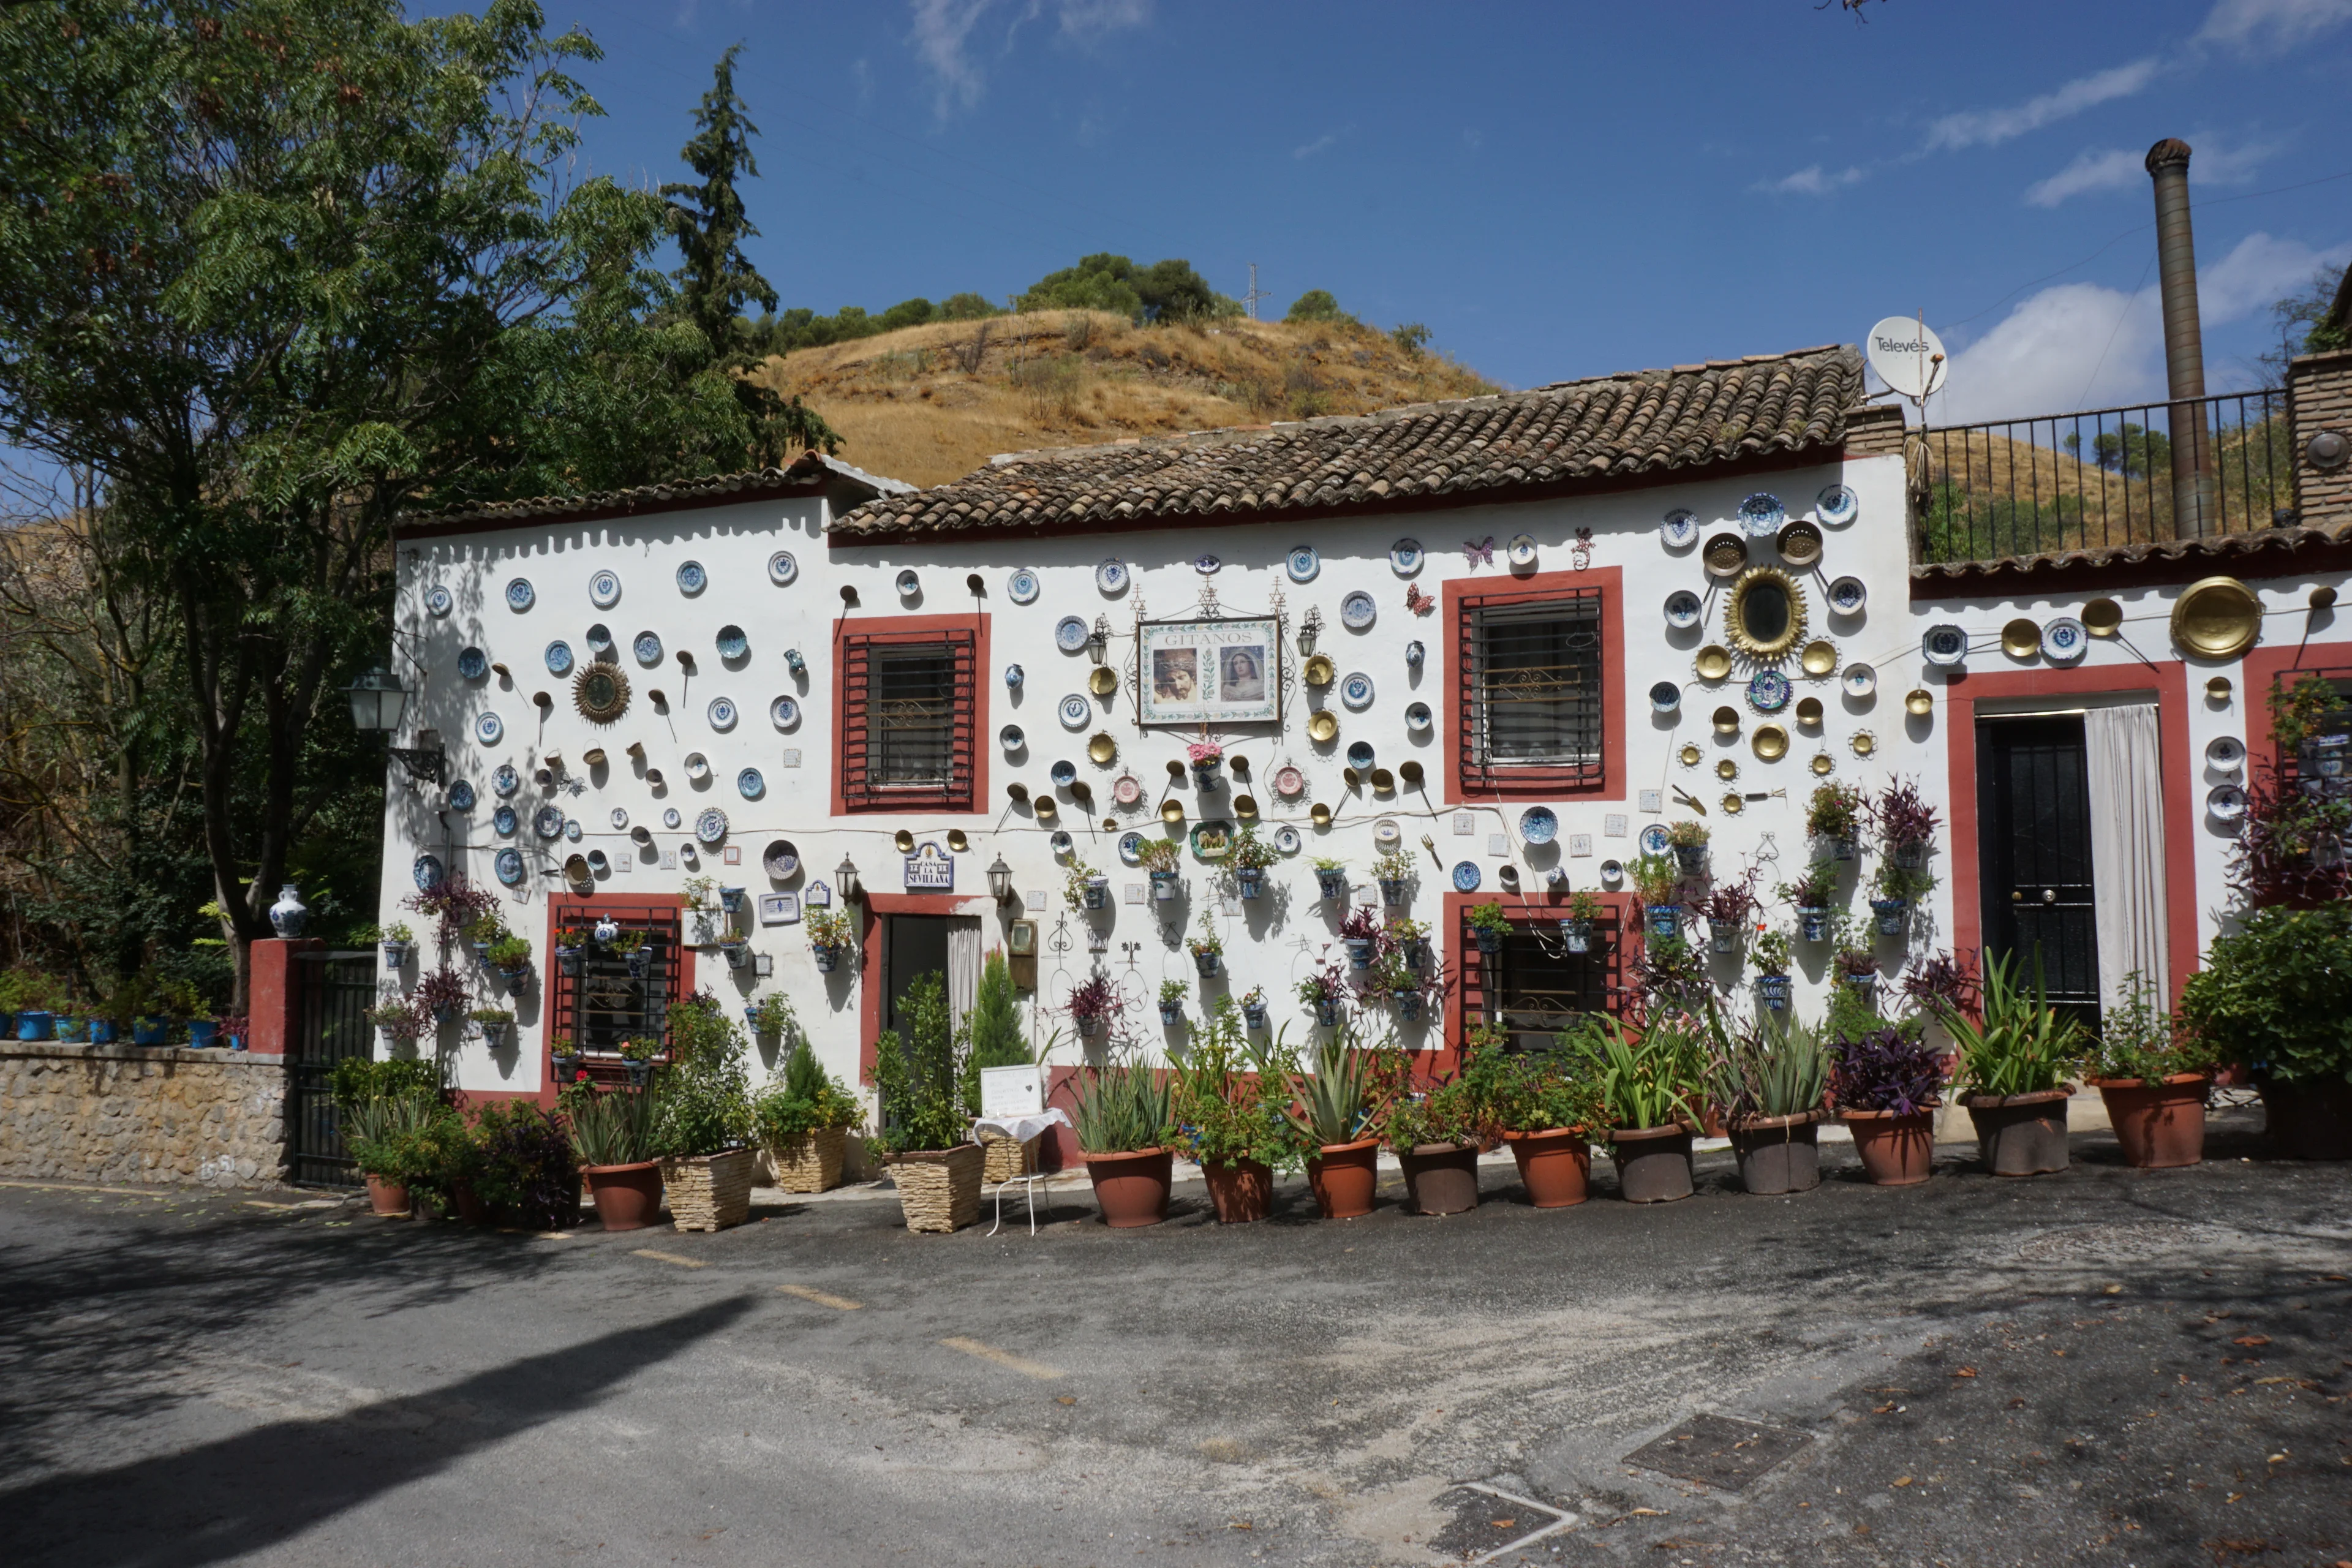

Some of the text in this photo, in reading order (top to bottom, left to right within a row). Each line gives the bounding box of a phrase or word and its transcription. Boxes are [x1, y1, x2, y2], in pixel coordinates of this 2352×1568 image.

[1875, 336, 1929, 352] Televés
[1165, 631, 1253, 646] GITANOS
[909, 875, 949, 883] SEVILLANA
